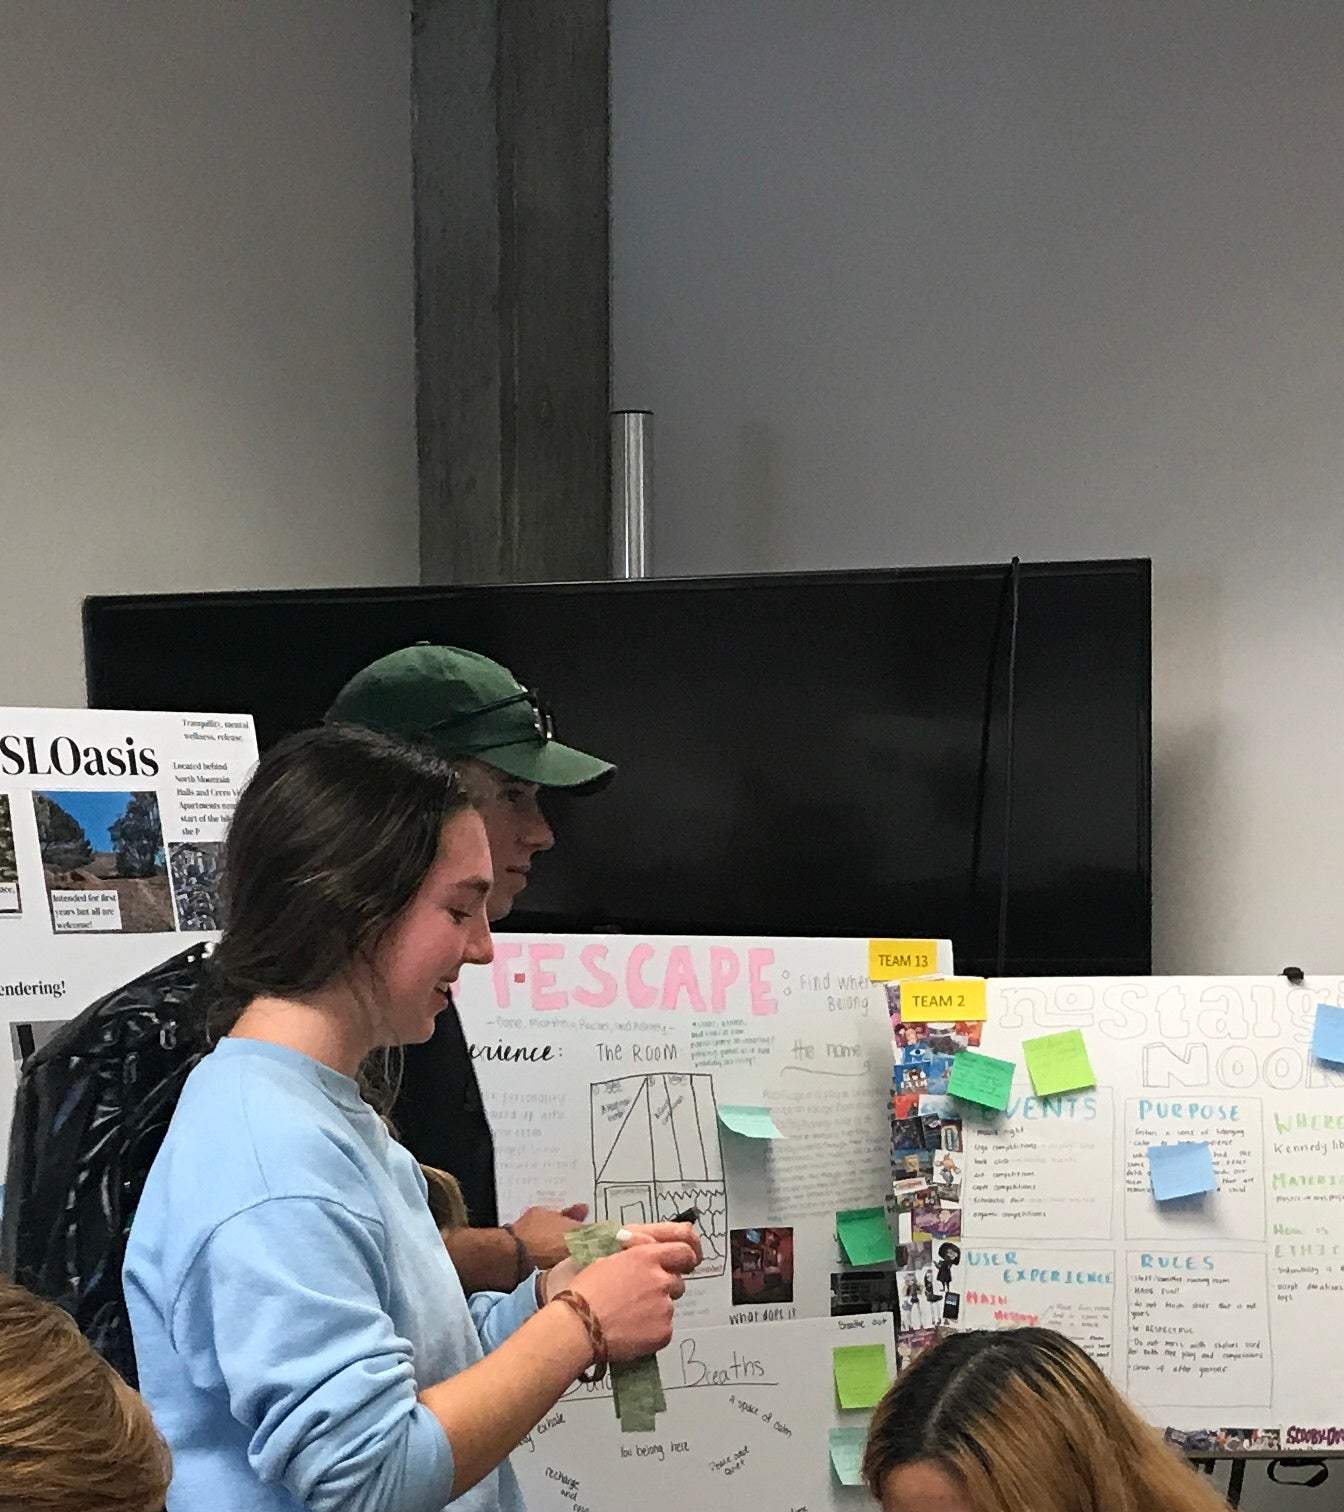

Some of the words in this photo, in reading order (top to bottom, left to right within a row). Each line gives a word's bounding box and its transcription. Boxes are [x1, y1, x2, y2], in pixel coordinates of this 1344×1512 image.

[878, 953, 912, 968] TEAM
[915, 954, 929, 968] 13
[911, 995, 953, 1008] TEAM
[957, 994, 966, 1007] 2
[991, 1098, 1097, 1122] VENTS
[679, 1337, 767, 1387] Breaths
